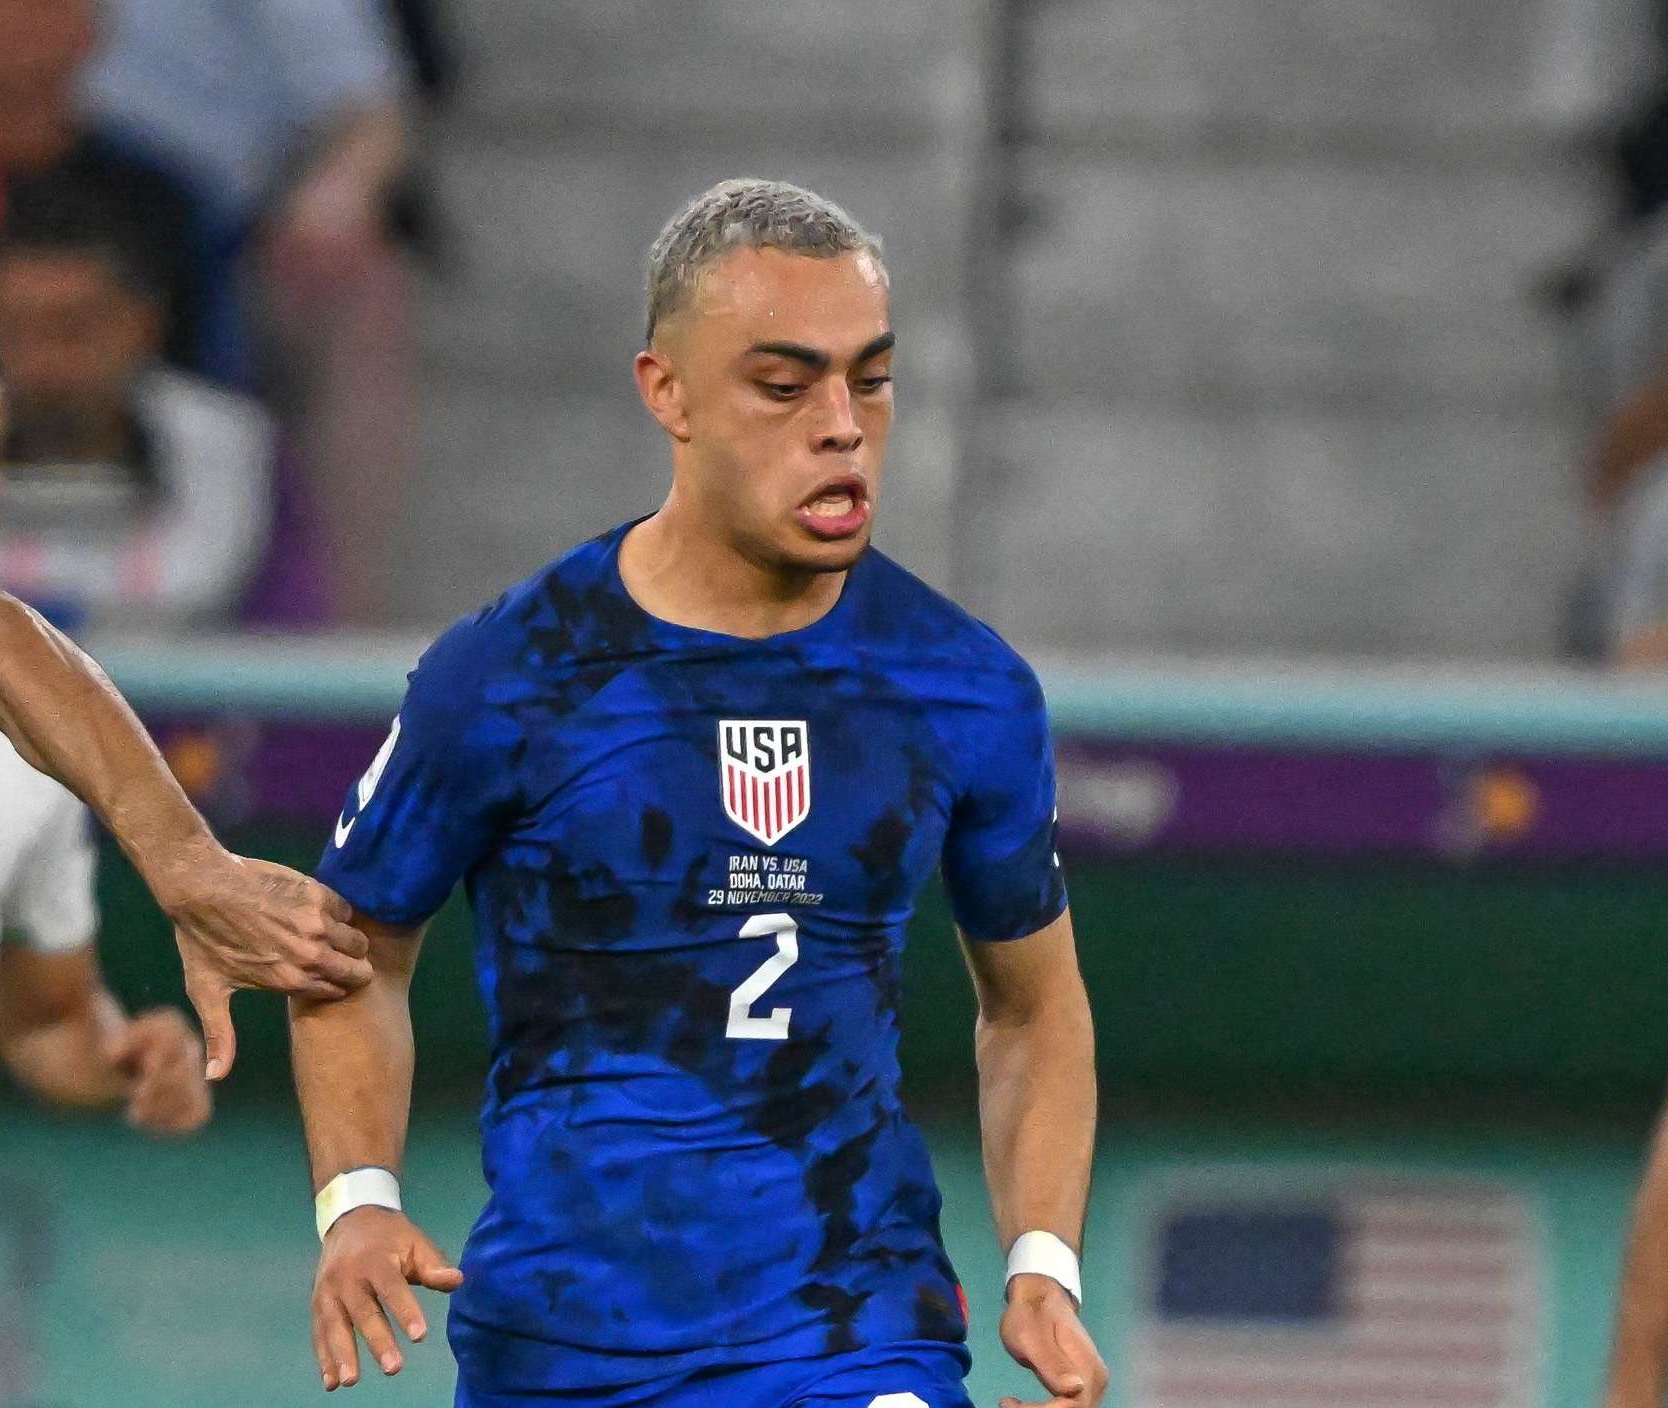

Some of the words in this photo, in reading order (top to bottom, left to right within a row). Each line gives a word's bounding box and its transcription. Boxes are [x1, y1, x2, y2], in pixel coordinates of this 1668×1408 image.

[725, 726, 803, 774] USA
[728, 855, 759, 872] IRAN
[761, 856, 780, 872] VS.
[783, 858, 808, 873] USA
[729, 872, 765, 890] DOHA,
[767, 873, 806, 890] QATAR
[707, 889, 725, 905] 29
[726, 890, 790, 905] NOVEMBER
[791, 892, 824, 905] 2022
[725, 912, 799, 1040] 2
